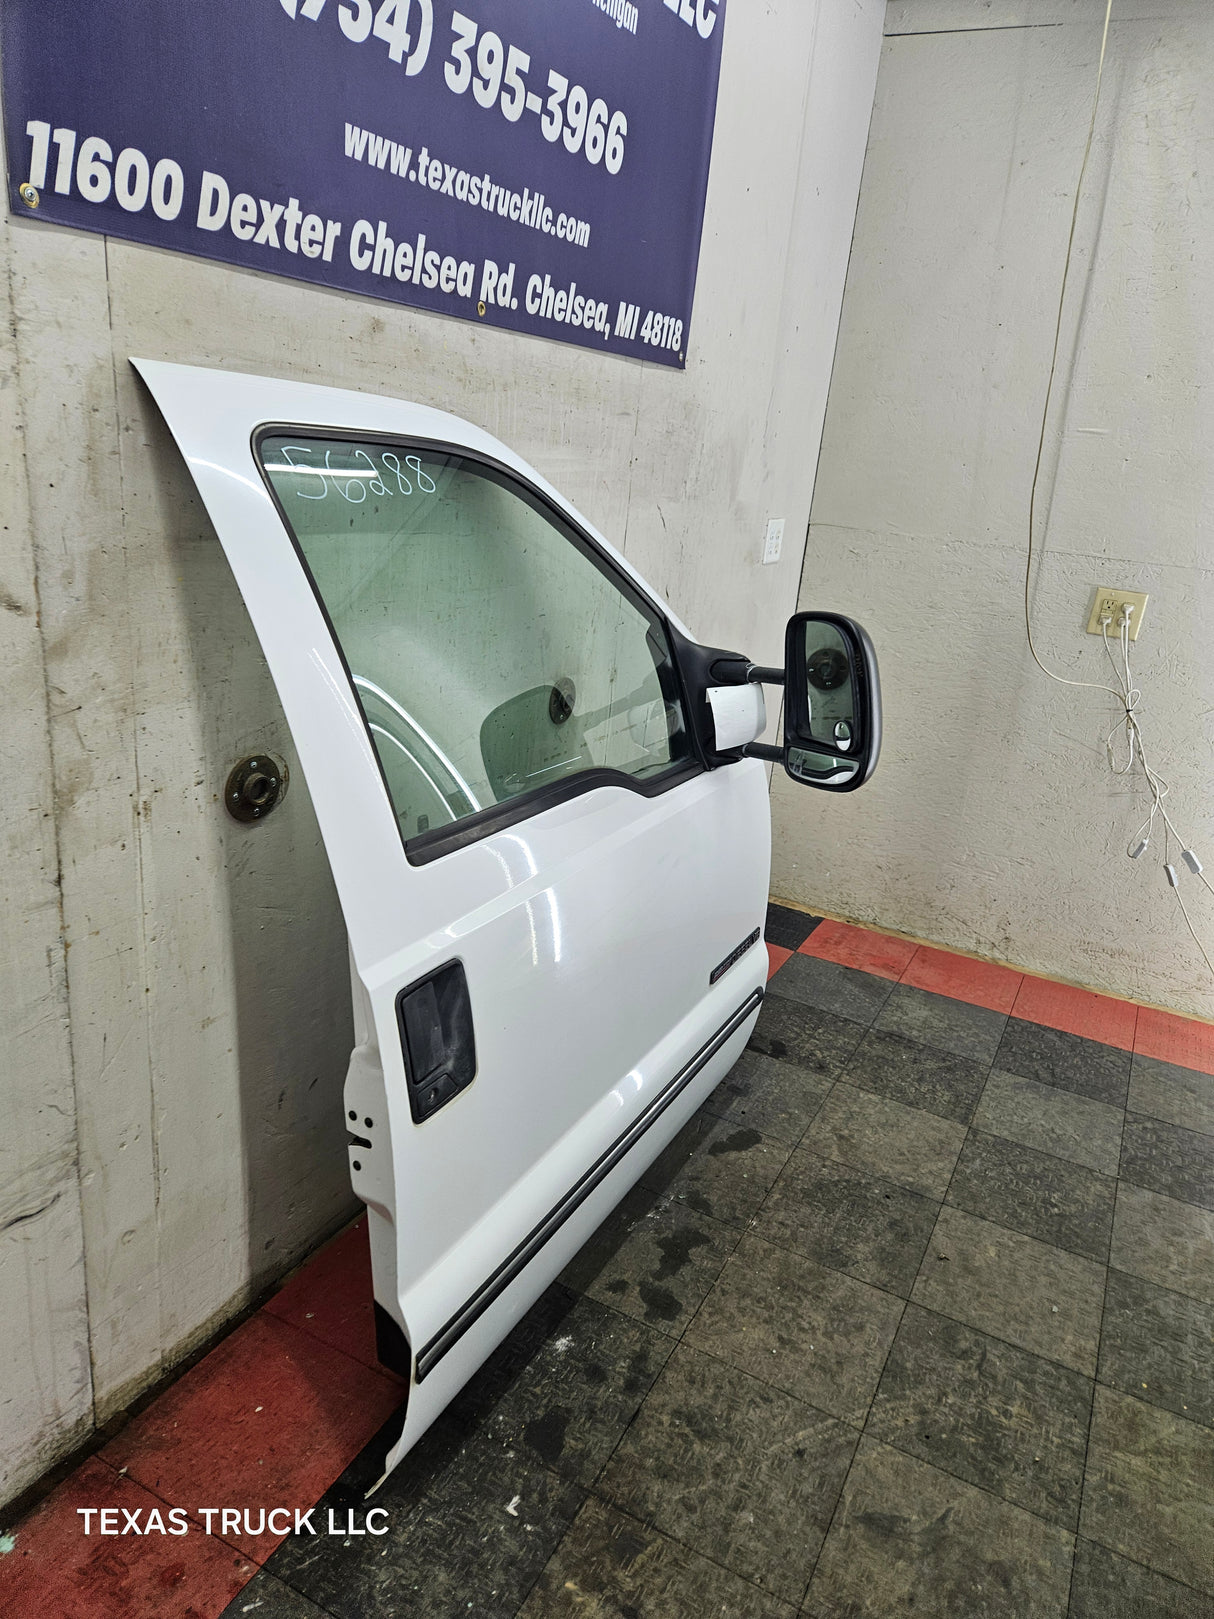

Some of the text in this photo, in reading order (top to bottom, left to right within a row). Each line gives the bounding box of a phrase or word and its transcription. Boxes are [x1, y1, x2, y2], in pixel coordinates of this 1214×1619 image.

[444, 11, 627, 174] 395-3966
[26, 120, 683, 351] 11600 Dexter Chelsea Rd. Chelsea, MI 48118
[345, 123, 590, 247] www.texastruckllc.com
[281, 446, 436, 503] 56288
